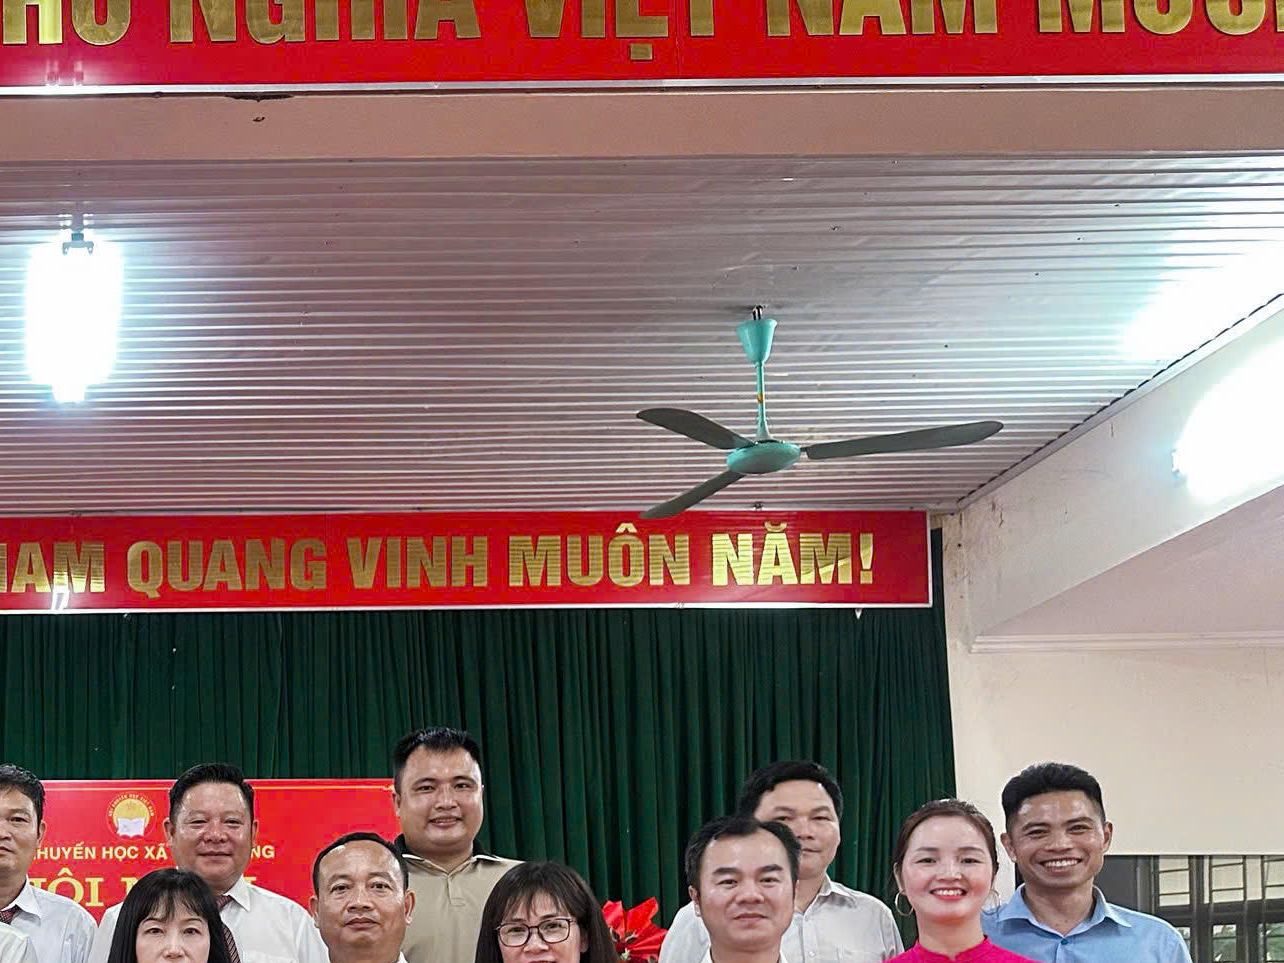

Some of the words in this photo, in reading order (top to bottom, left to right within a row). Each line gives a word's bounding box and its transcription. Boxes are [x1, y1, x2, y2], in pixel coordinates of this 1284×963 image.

[126, 537, 327, 599] QUANG
[346, 536, 489, 590] VINH
[508, 522, 691, 588] MUÔN
[711, 521, 875, 587] NĂM!
[33, 841, 96, 860] HUYẾN
[101, 846, 139, 861] HỌC
[145, 843, 168, 860] XÃ
